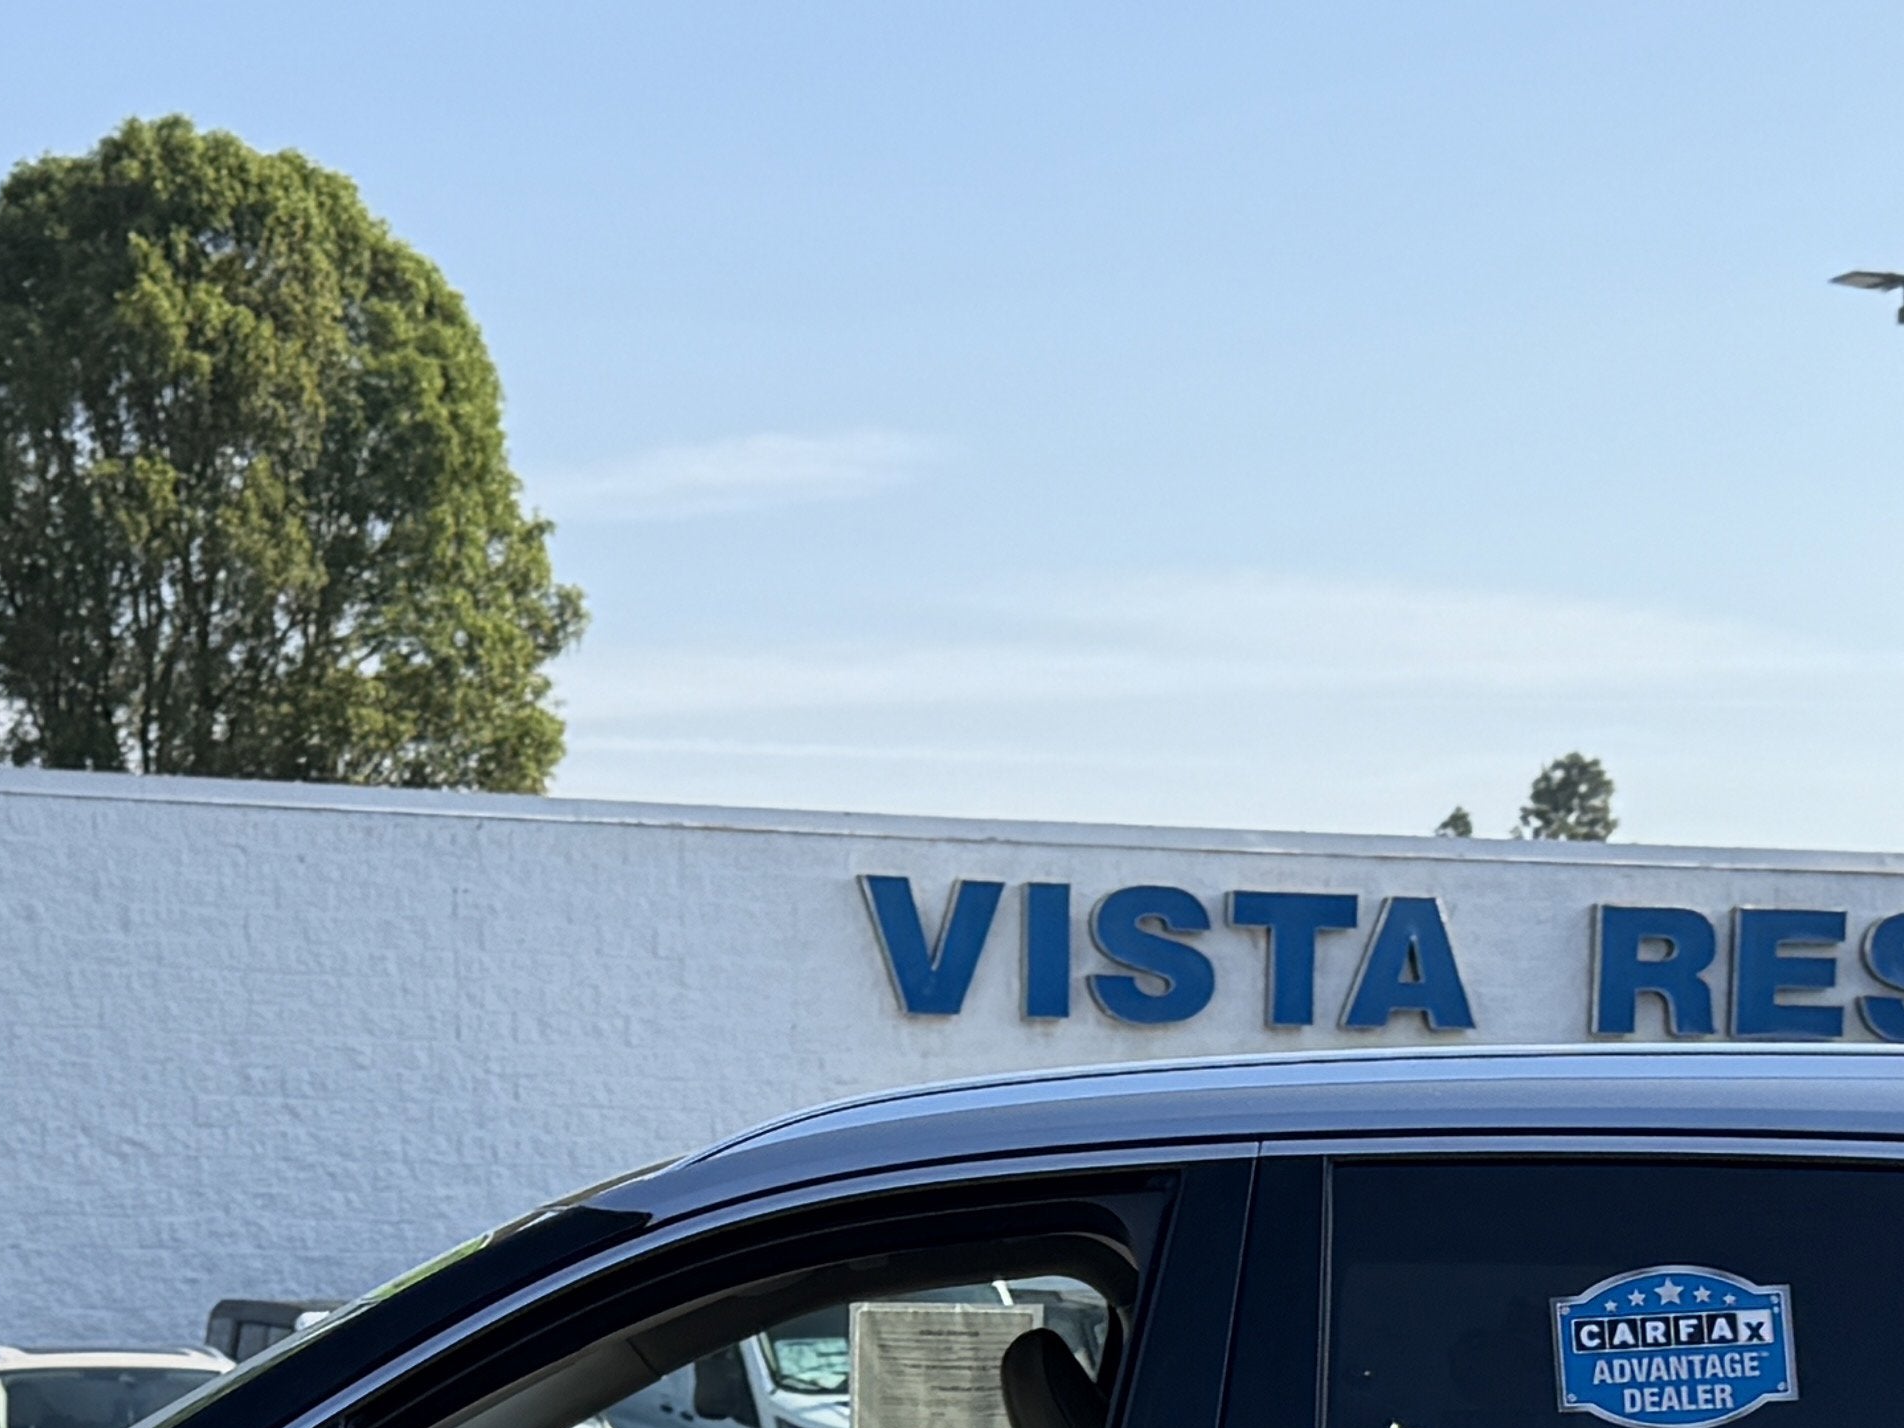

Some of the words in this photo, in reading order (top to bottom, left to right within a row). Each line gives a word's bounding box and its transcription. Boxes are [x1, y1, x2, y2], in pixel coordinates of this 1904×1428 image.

[856, 873, 1477, 1030] VISTA
[1578, 1316, 1766, 1348] CARFAX
[1592, 1352, 1761, 1385] ADVANTAGE
[1623, 1384, 1735, 1414] DEALER
